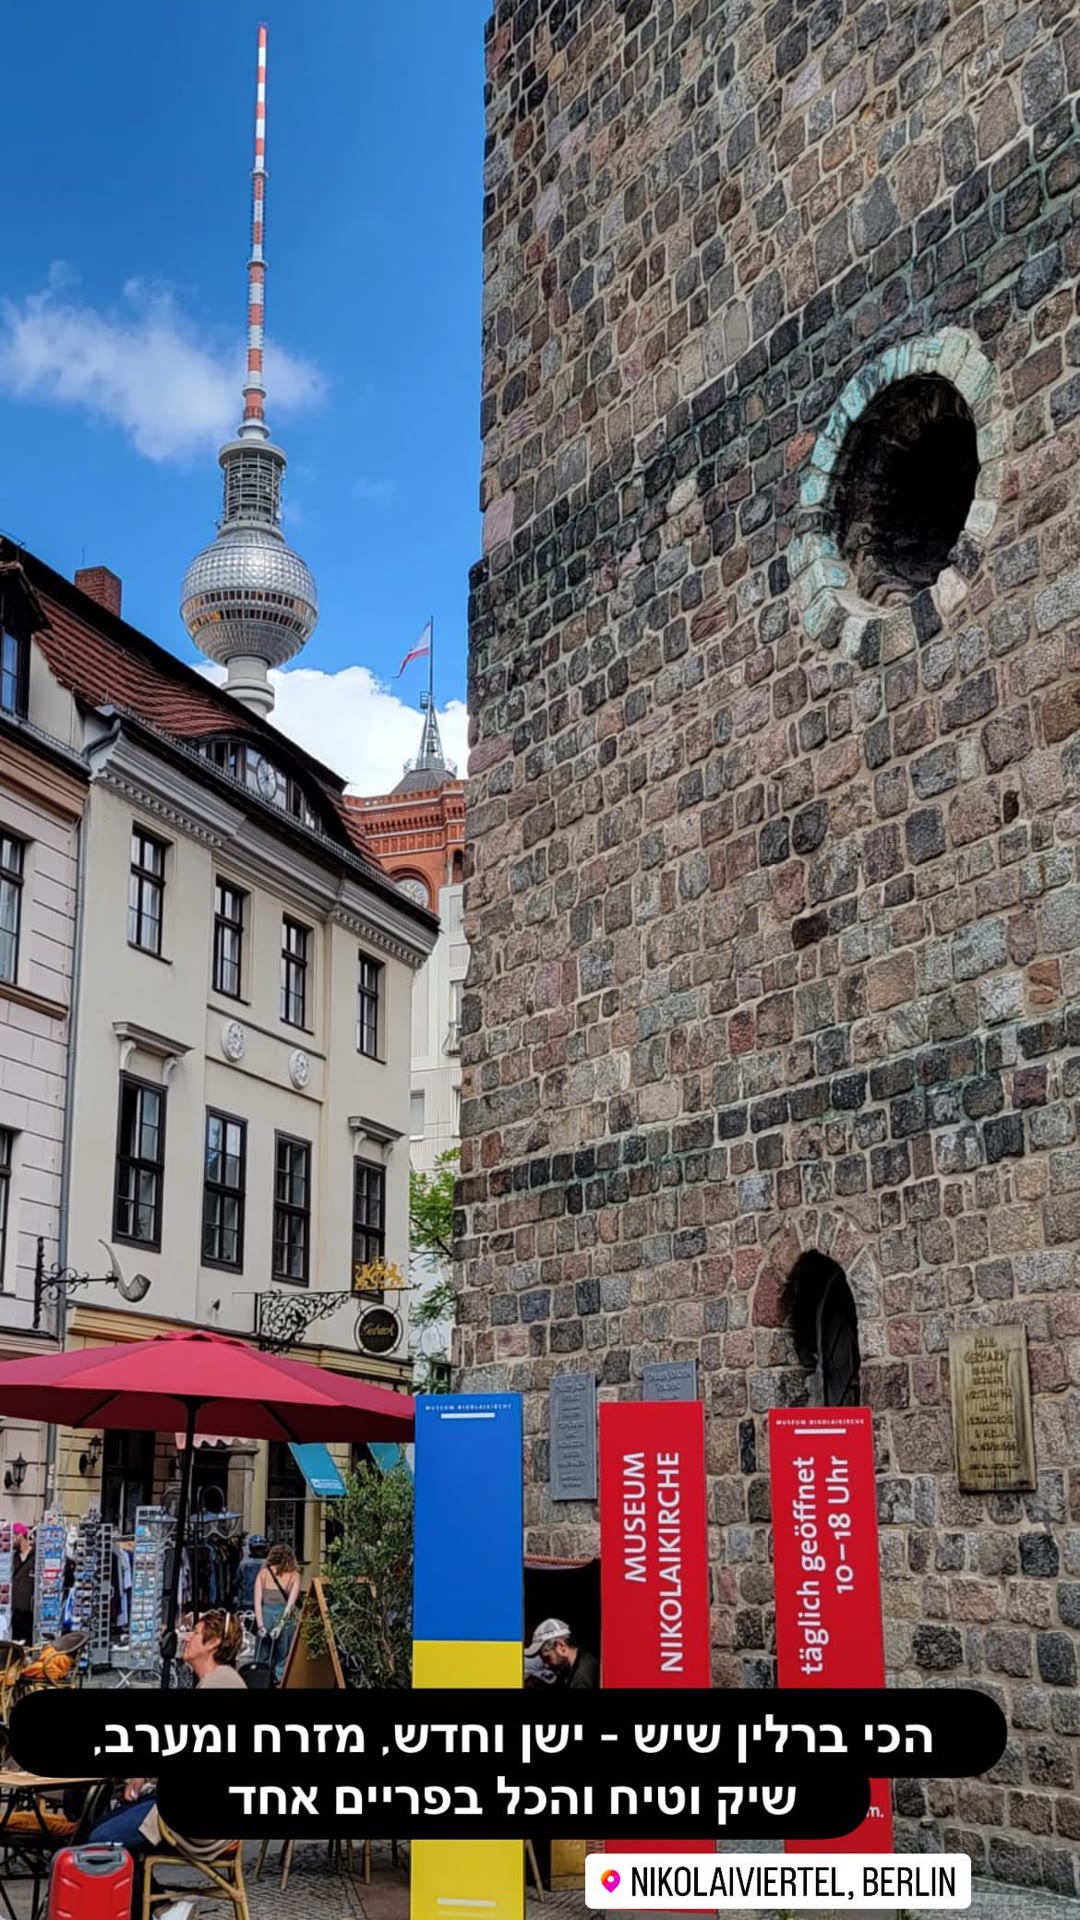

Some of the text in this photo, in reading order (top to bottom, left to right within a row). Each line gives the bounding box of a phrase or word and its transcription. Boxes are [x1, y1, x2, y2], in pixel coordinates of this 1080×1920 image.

[623, 1452, 648, 1583] MUSEUM
[657, 1452, 684, 1672] NIKOLAIKIRCHE
[793, 1456, 830, 1675] täglich geöffnet
[824, 1455, 851, 1504] Uhr
